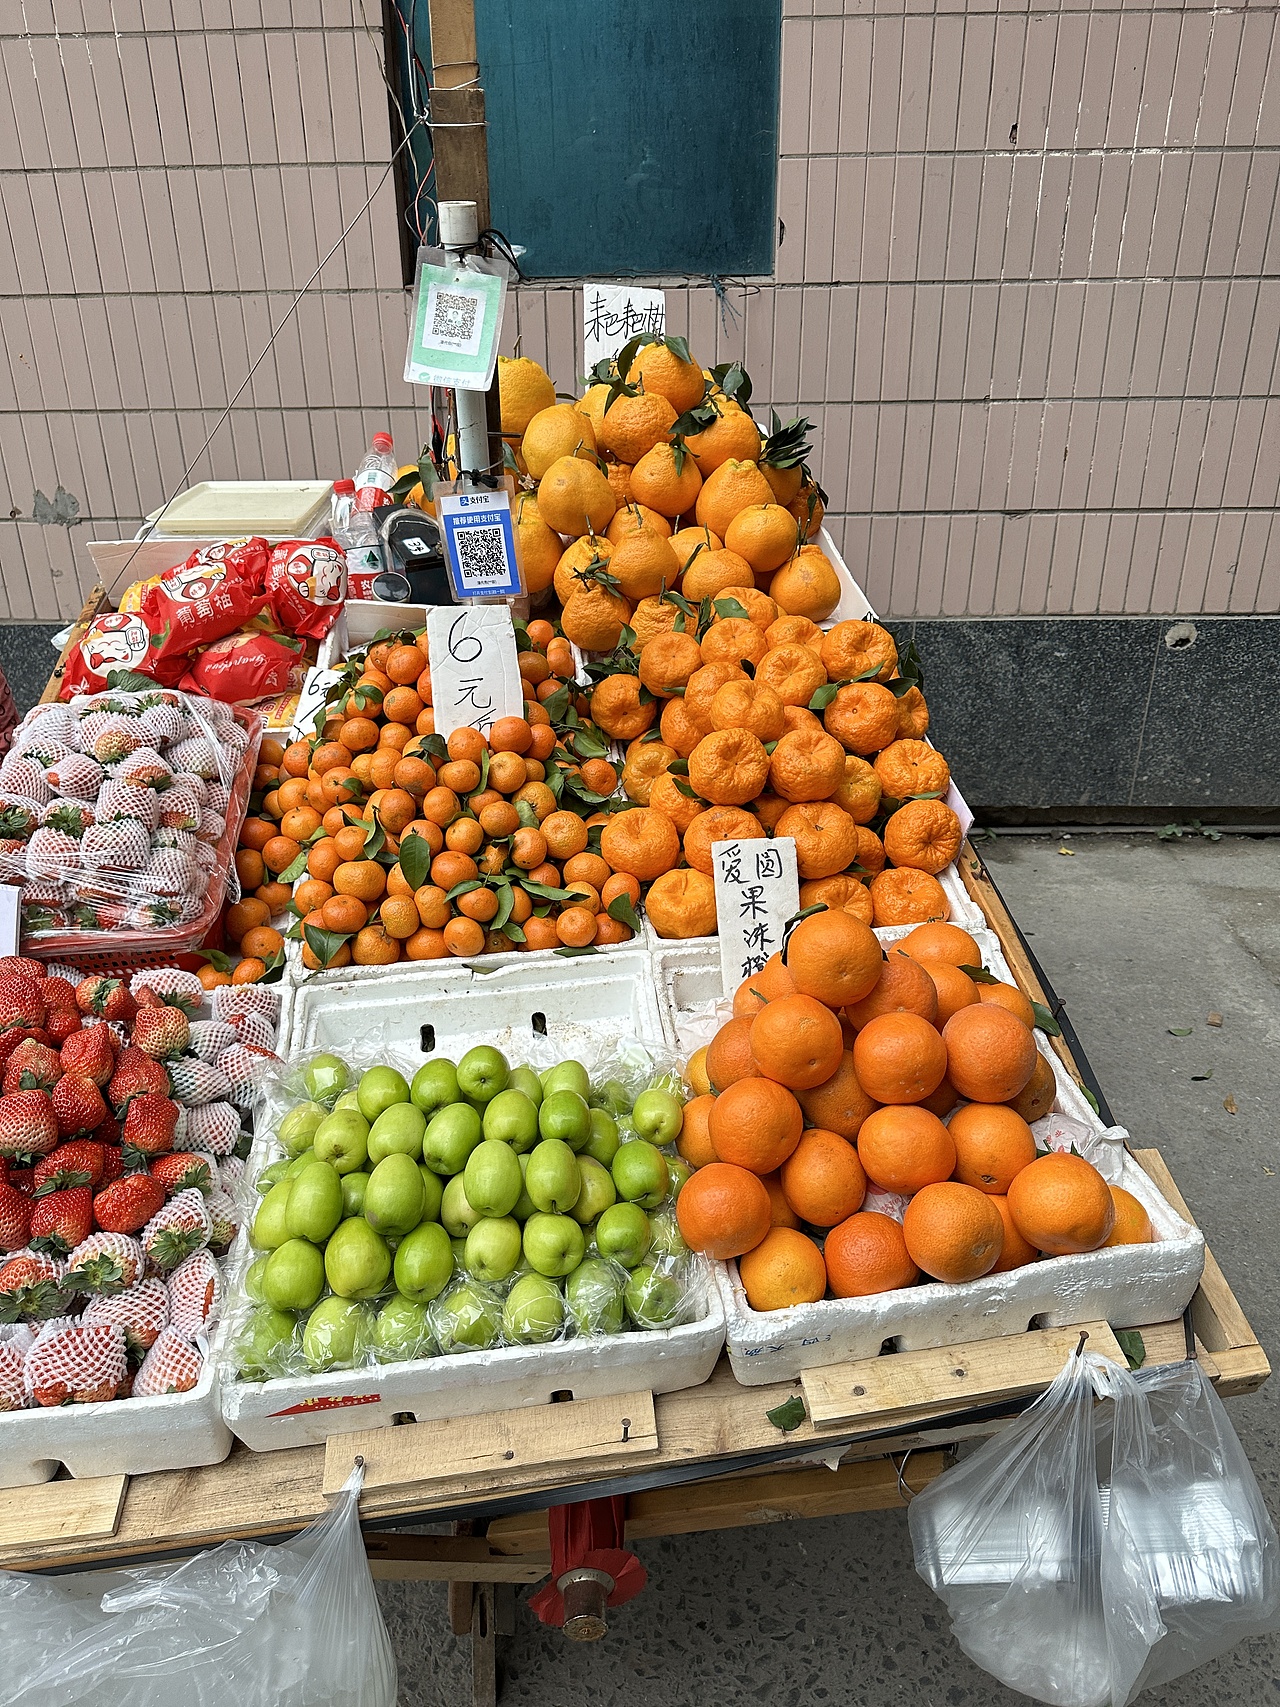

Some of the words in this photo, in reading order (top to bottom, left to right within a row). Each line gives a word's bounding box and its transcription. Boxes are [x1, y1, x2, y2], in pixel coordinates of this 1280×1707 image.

[469, 495, 490, 505] 支付宝
[452, 513, 502, 526] 推荐使用支付宝
[176, 592, 234, 627] 葡萄柚
